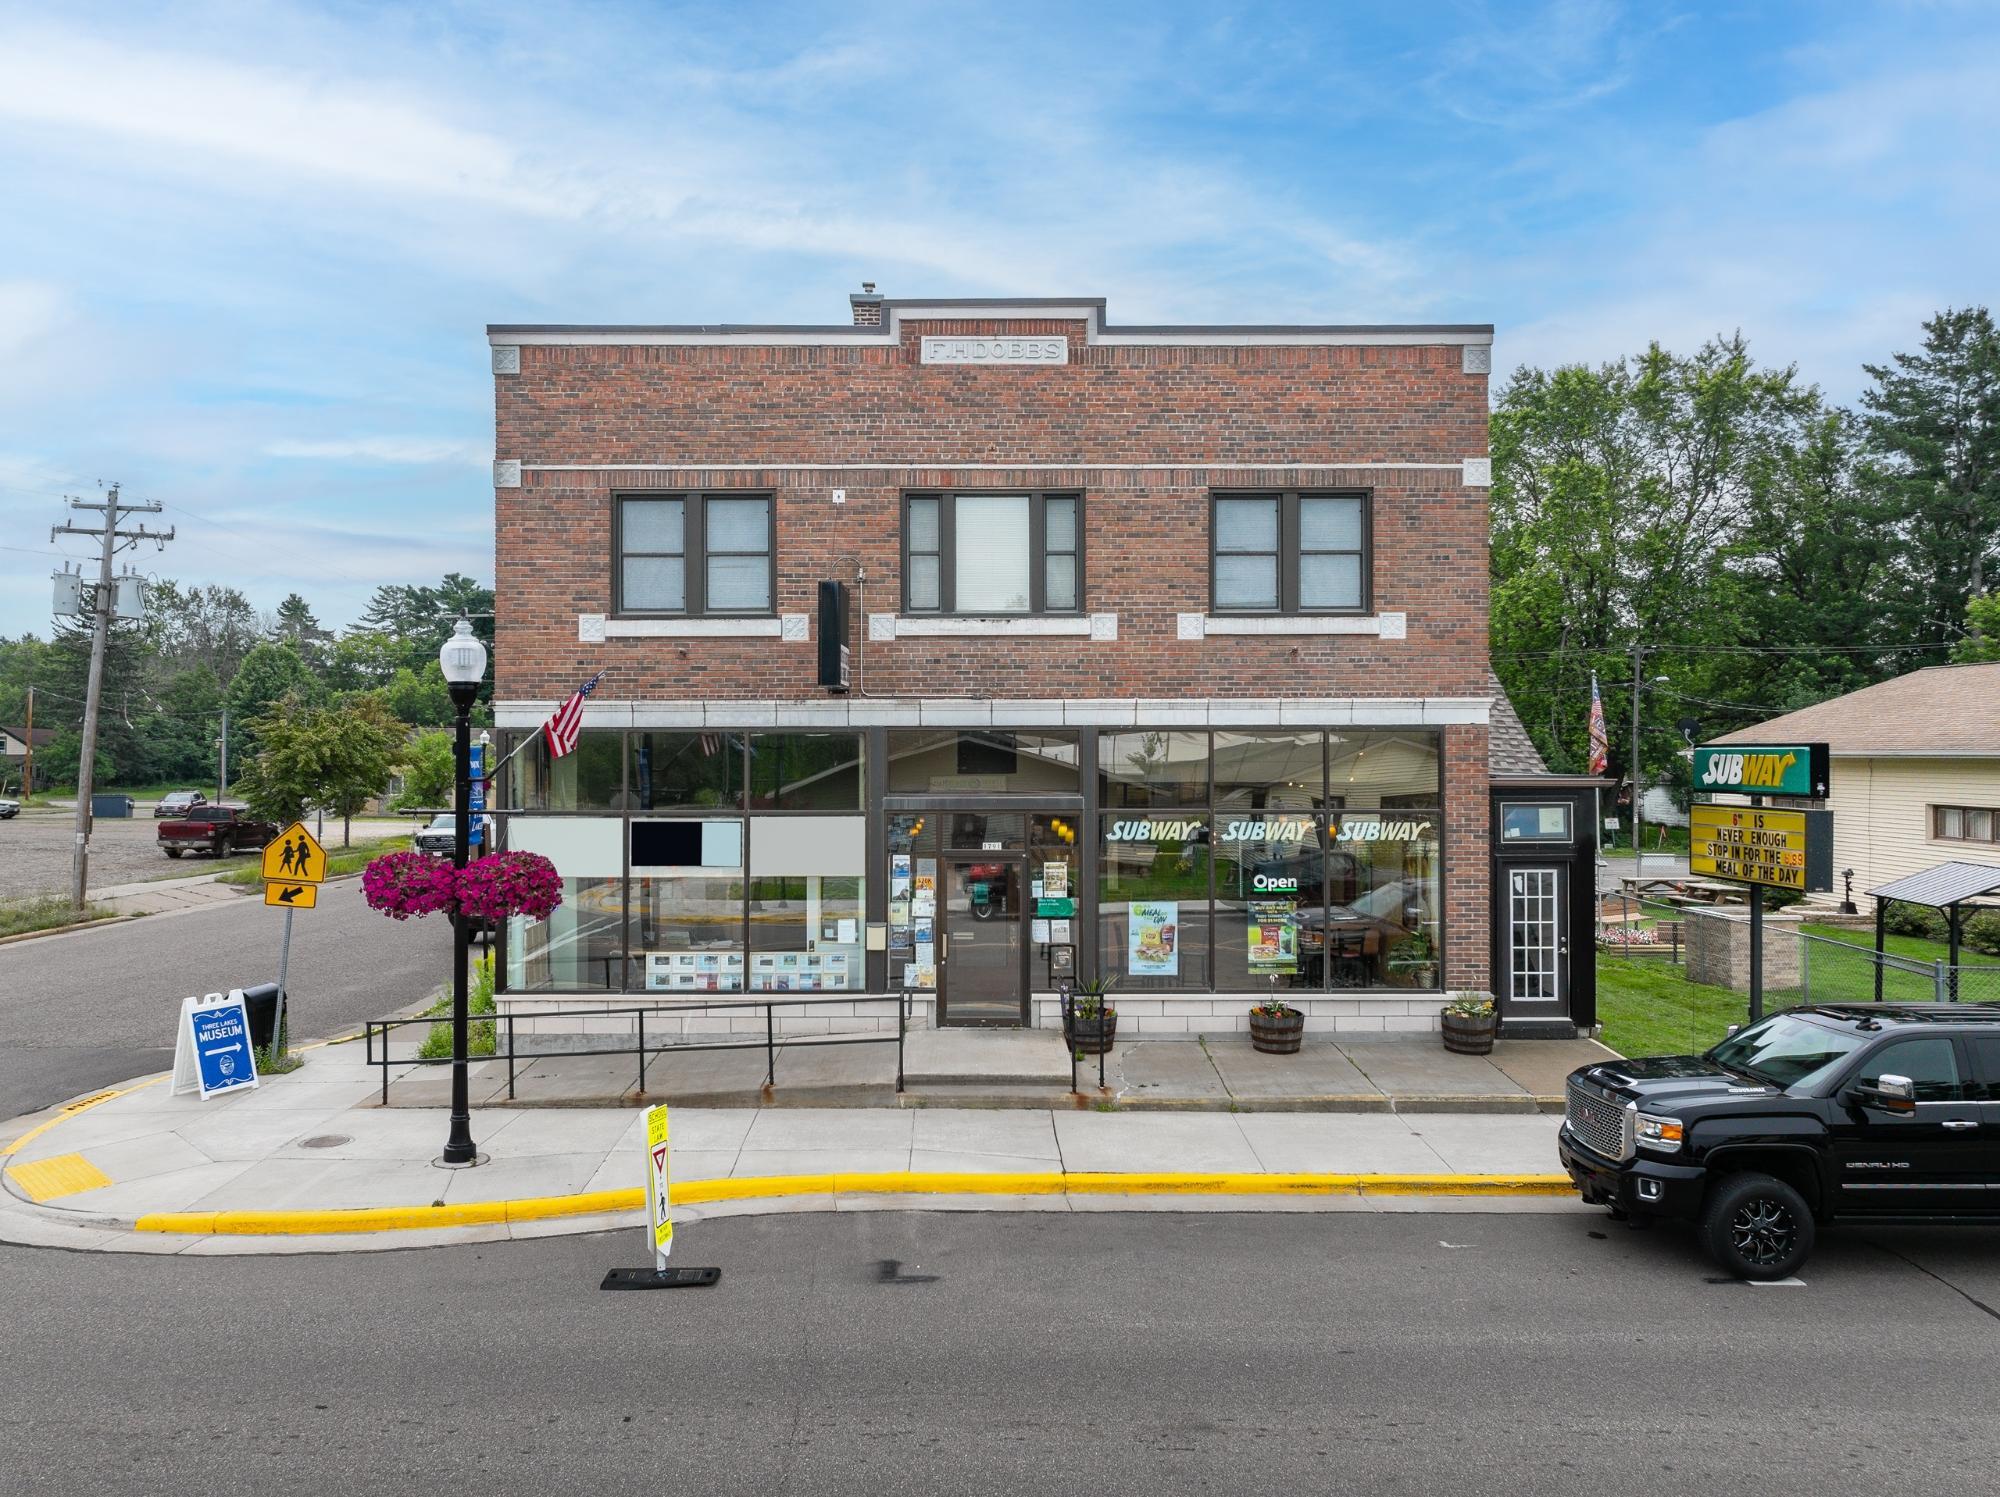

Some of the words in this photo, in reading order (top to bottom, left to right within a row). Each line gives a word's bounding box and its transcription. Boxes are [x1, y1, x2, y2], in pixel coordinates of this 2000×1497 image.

[1702, 752, 1796, 786] SUBWAY
[1106, 820, 1202, 841] SUBWAY
[1221, 821, 1317, 841] SUBWAY
[1336, 821, 1431, 841] SUBWAY
[1754, 815, 1764, 828] IS
[1717, 828, 1744, 843] NEVER
[1751, 831, 1787, 848] ENOUGH
[1707, 843, 1728, 856] STOP
[1731, 846, 1740, 859] IN
[1744, 847, 1760, 861] FOR
[1764, 849, 1781, 865] THE
[1716, 860, 1738, 875] MEAL
[1742, 864, 1754, 877] OF
[1758, 865, 1774, 881] THE
[1779, 868, 1798, 883] DAY
[1253, 874, 1297, 891] Open
[199, 1025, 242, 1042] MUSEUM
[202, 1022, 219, 1030] THREE
[220, 1018, 238, 1026] LAKES
[651, 1123, 664, 1134] STATE
